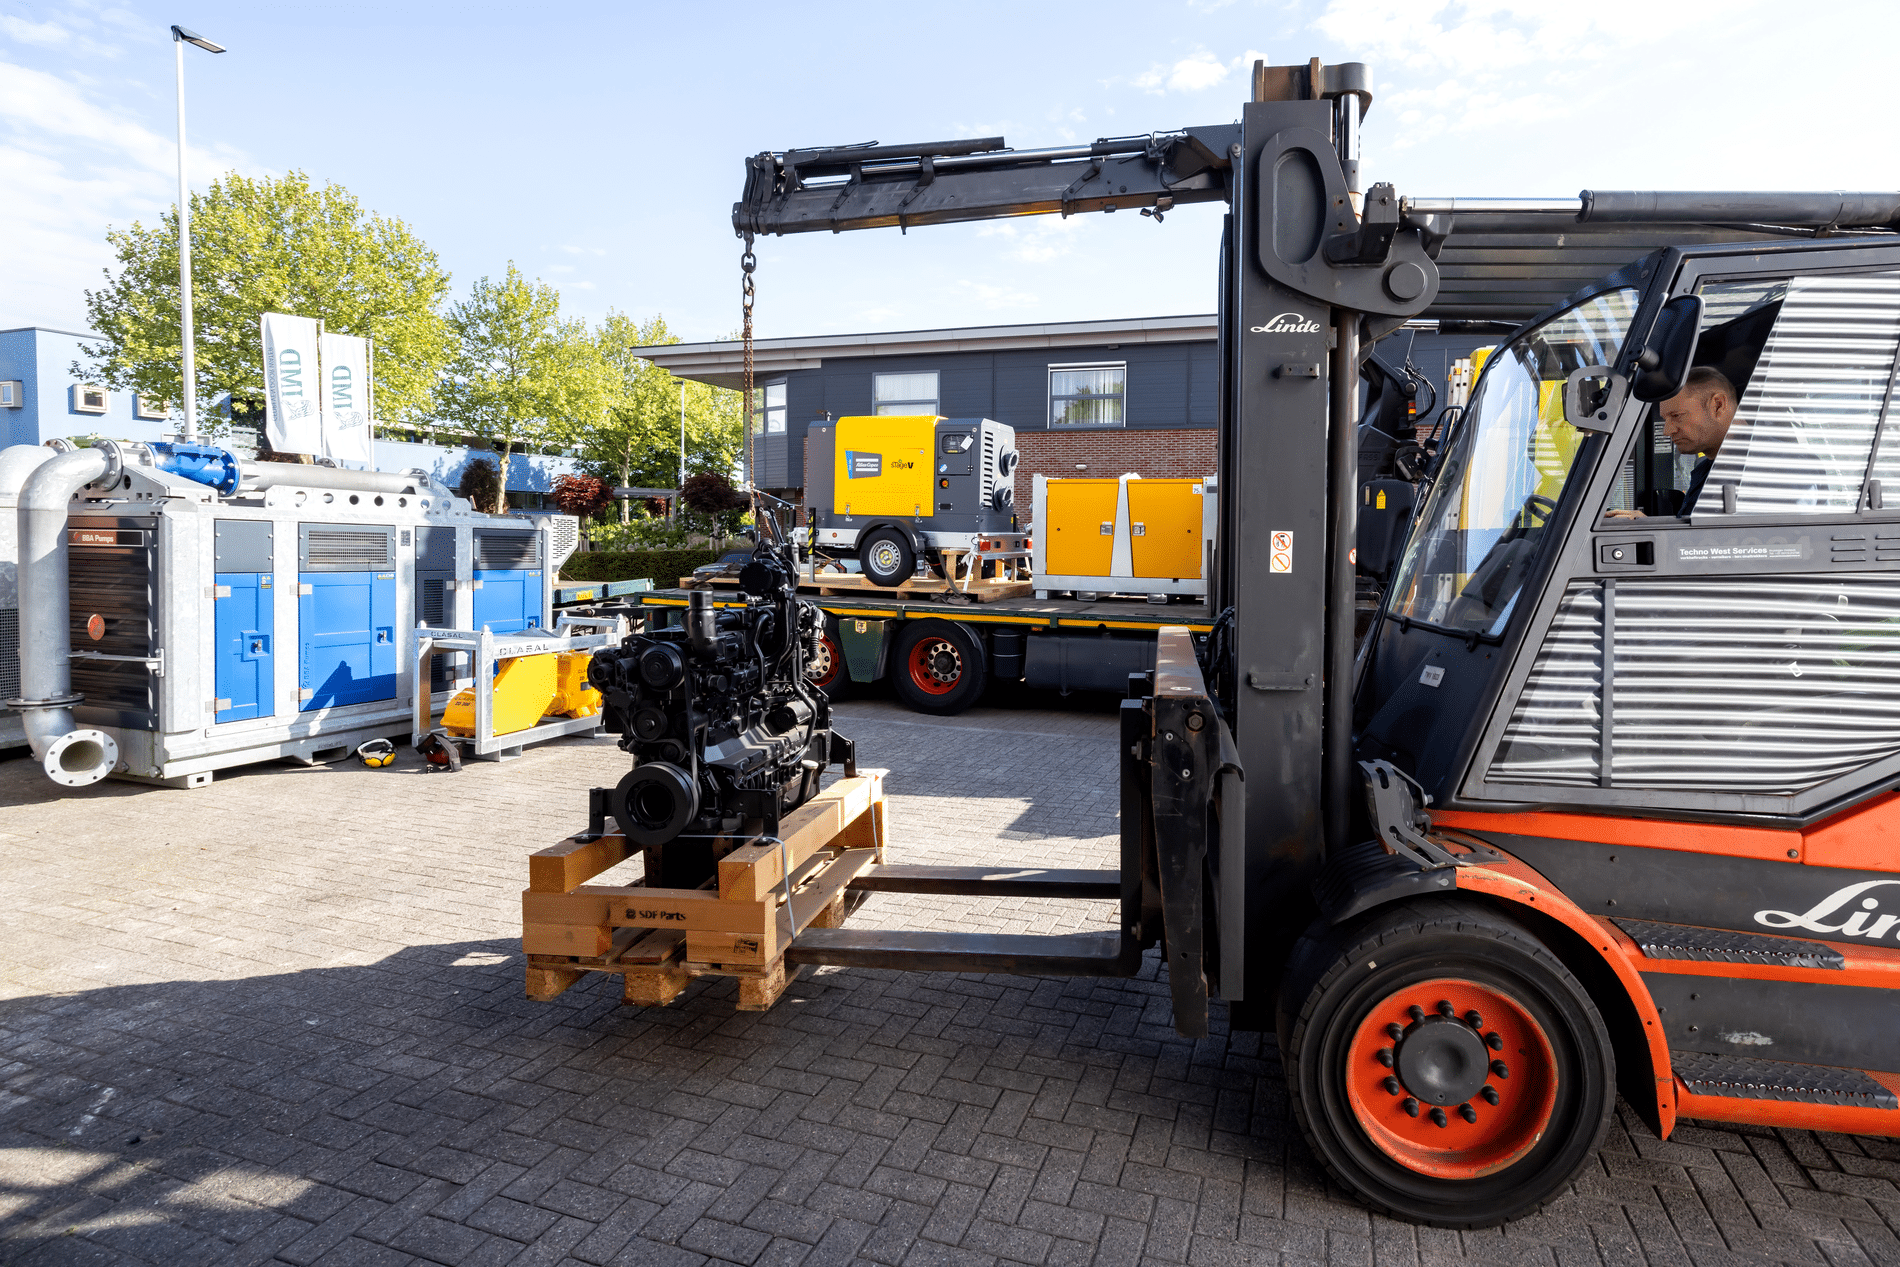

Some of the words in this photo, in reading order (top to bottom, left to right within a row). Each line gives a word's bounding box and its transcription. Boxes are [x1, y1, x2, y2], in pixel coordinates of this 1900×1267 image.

[1250, 312, 1320, 333] Linde
[82, 534, 95, 542] BBA
[95, 534, 114, 544] Pumps
[1680, 548, 1709, 556] Techno
[1710, 547, 1731, 555] West
[1732, 547, 1768, 555] Services
[431, 631, 463, 639] CLASAL
[499, 643, 549, 656] CLASAL
[639, 910, 658, 919] SDF
[660, 910, 686, 921] Parts
